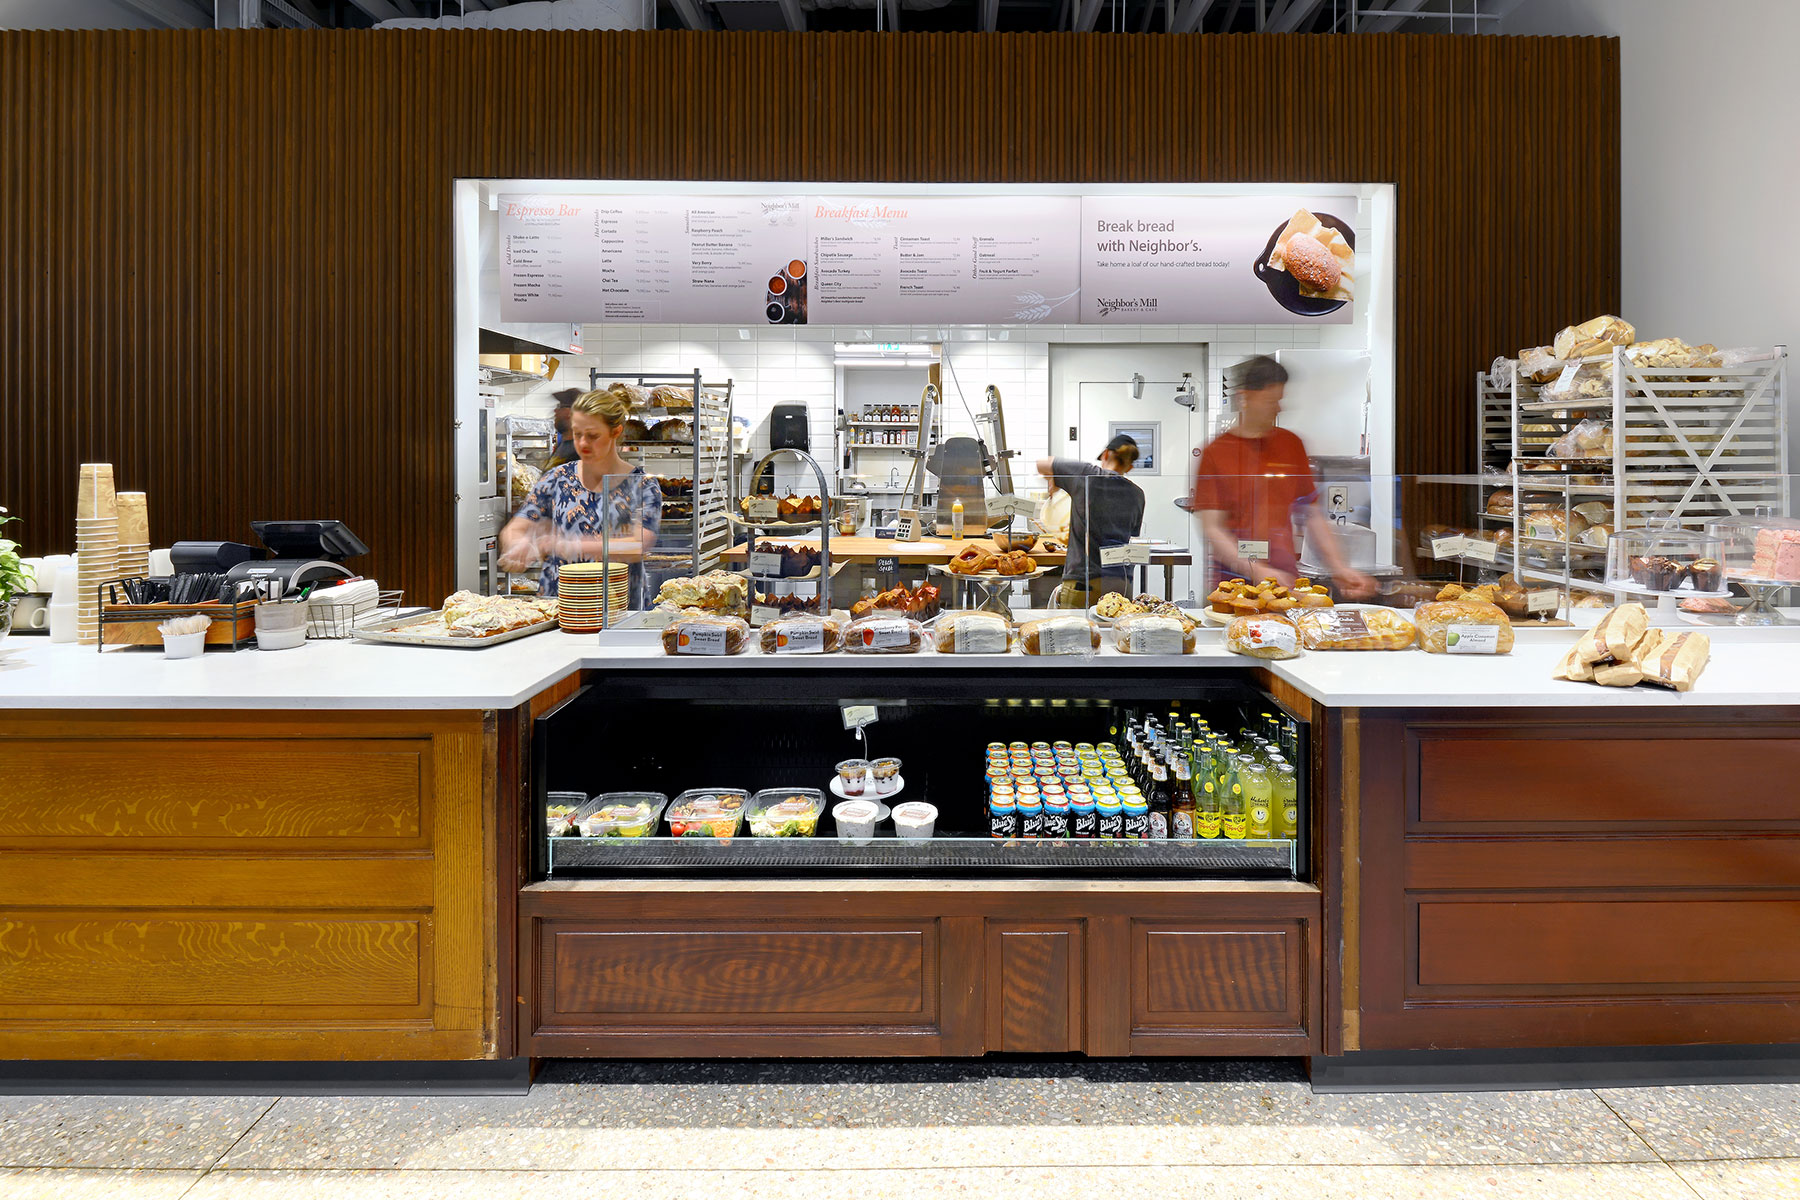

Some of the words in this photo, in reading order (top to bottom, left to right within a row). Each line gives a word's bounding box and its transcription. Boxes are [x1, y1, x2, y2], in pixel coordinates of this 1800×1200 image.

[505, 203, 555, 220] Espresso
[559, 204, 582, 216] Bar
[814, 205, 869, 223] Breakfast
[872, 206, 908, 218] Menu
[1097, 220, 1134, 232] Break
[1137, 220, 1174, 232] bread
[1097, 239, 1125, 252] with
[1129, 239, 1202, 255] Neighbor's.
[1212, 261, 1230, 269] today!
[1097, 298, 1138, 312] Neighbor's
[1140, 298, 1158, 307] Mill
[992, 818, 1008, 831] Blue
[1051, 815, 1068, 832] Sky
[1100, 818, 1116, 832] Blue
[1126, 818, 1142, 832] Blue
